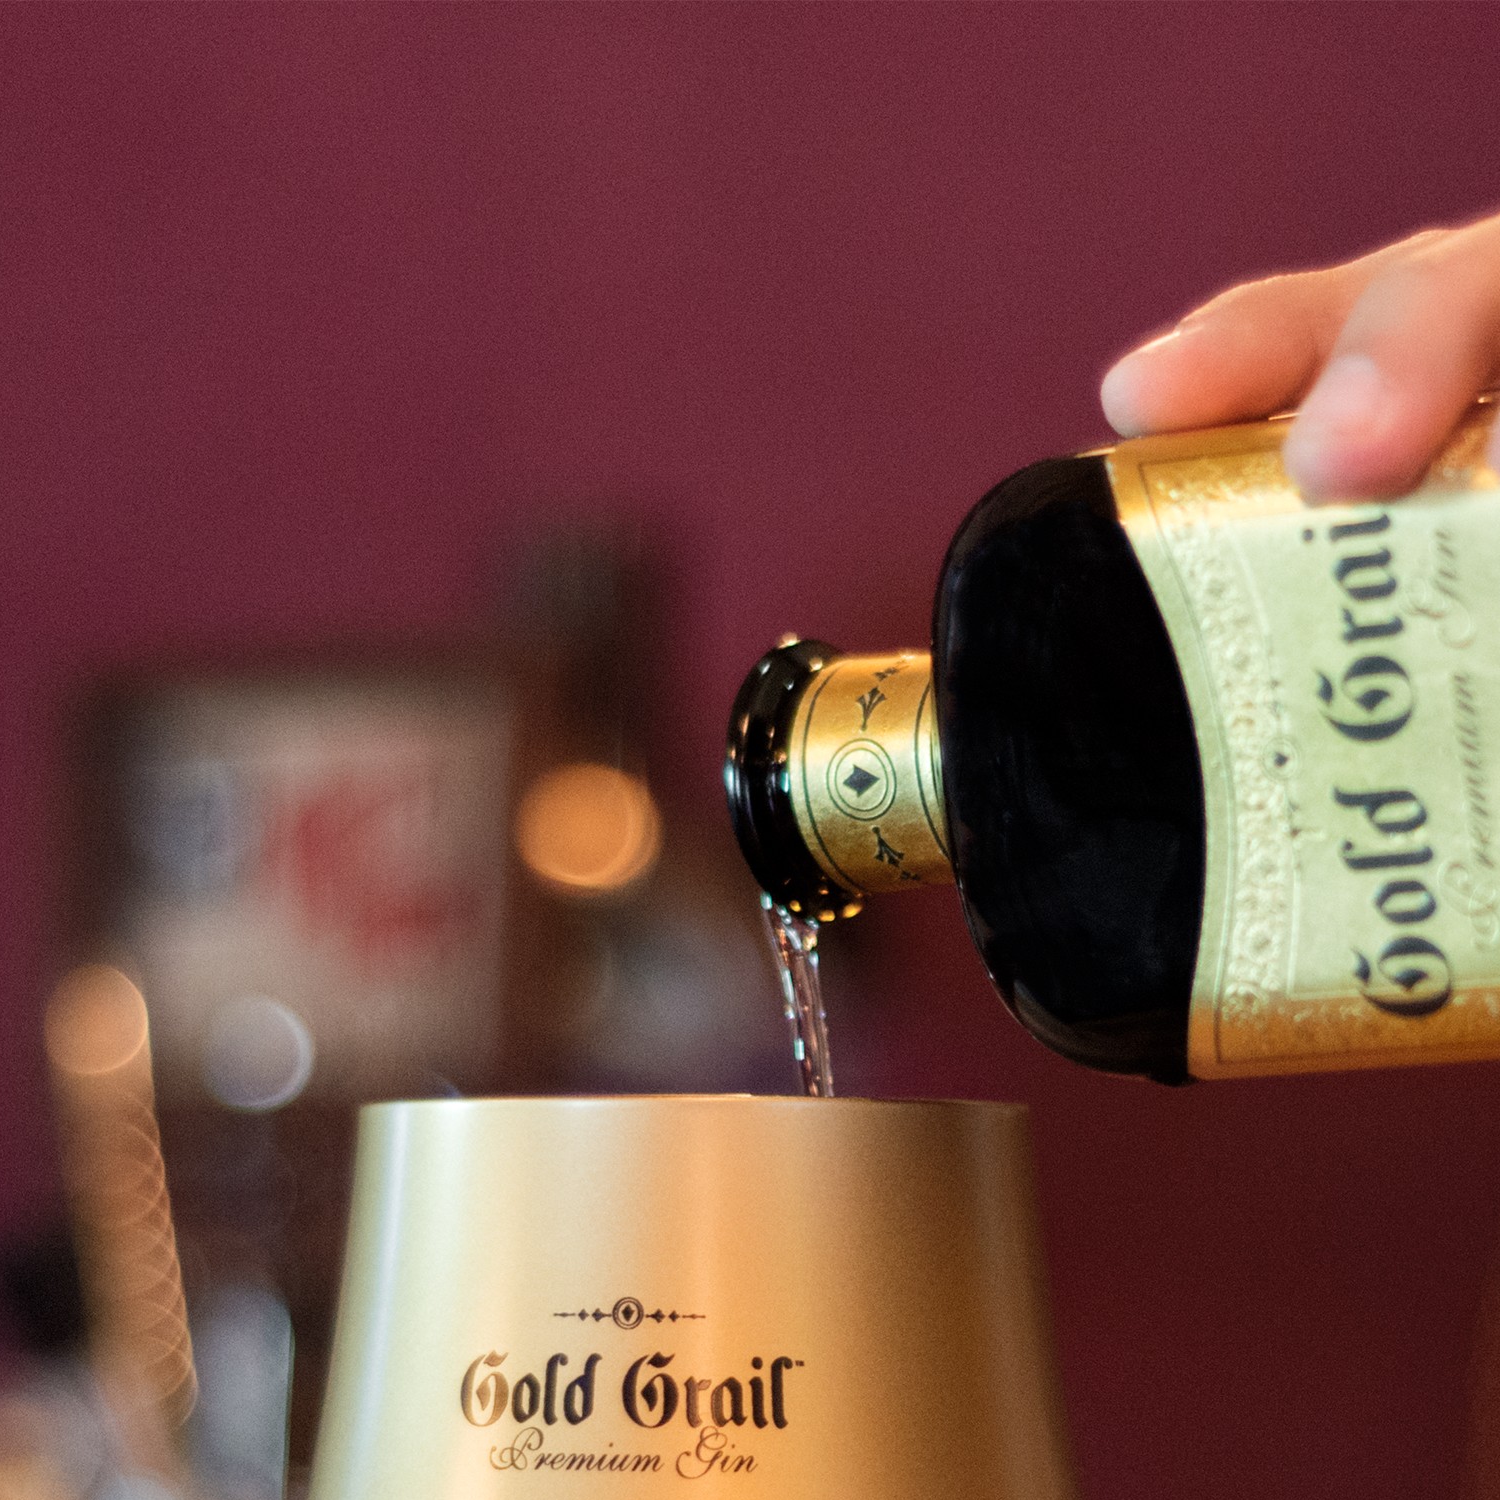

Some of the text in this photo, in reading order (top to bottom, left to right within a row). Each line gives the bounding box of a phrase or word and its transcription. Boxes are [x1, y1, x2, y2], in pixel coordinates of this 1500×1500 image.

[1302, 514, 1453, 1019] Gold Grai
[1406, 528, 1500, 951] Premium Gin
[460, 1350, 793, 1429] Gold Grail
[488, 1426, 759, 1479] Premium Gin
